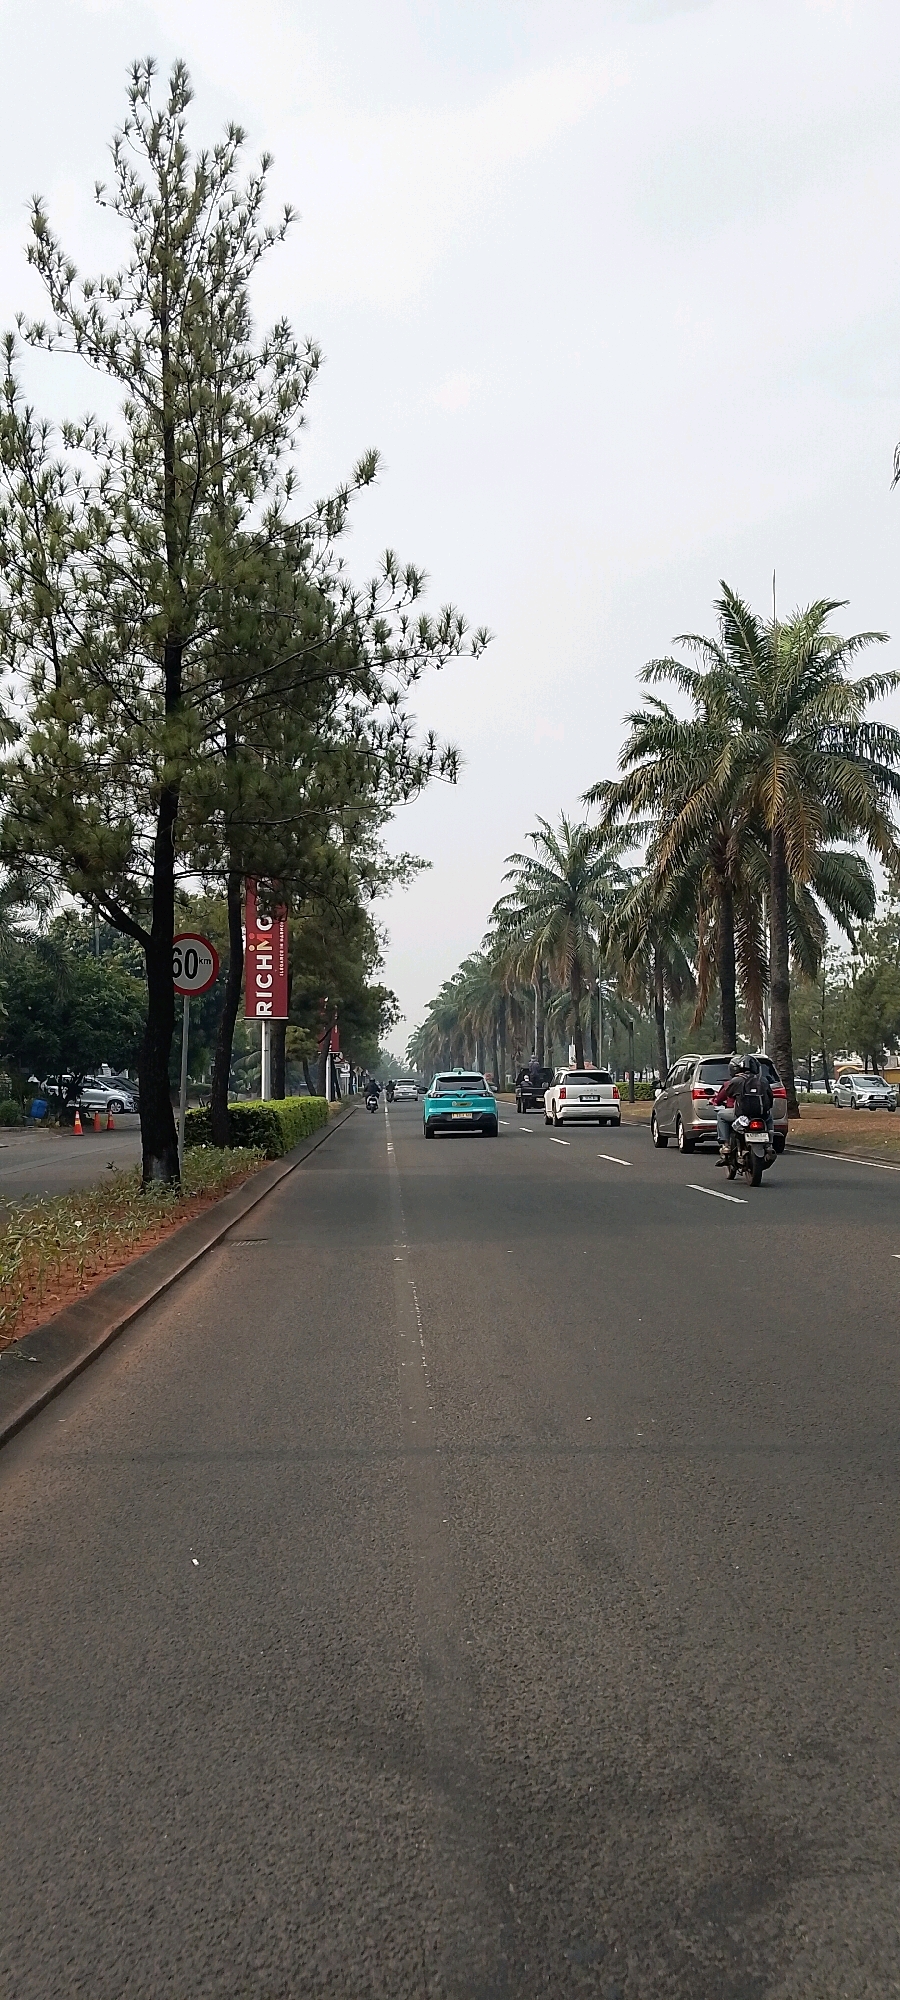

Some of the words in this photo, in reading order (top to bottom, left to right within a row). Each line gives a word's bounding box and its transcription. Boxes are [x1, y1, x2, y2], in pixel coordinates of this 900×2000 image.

[172, 947, 198, 979] 60
[199, 957, 211, 965] km
[256, 877, 273, 1016] RICHMO
